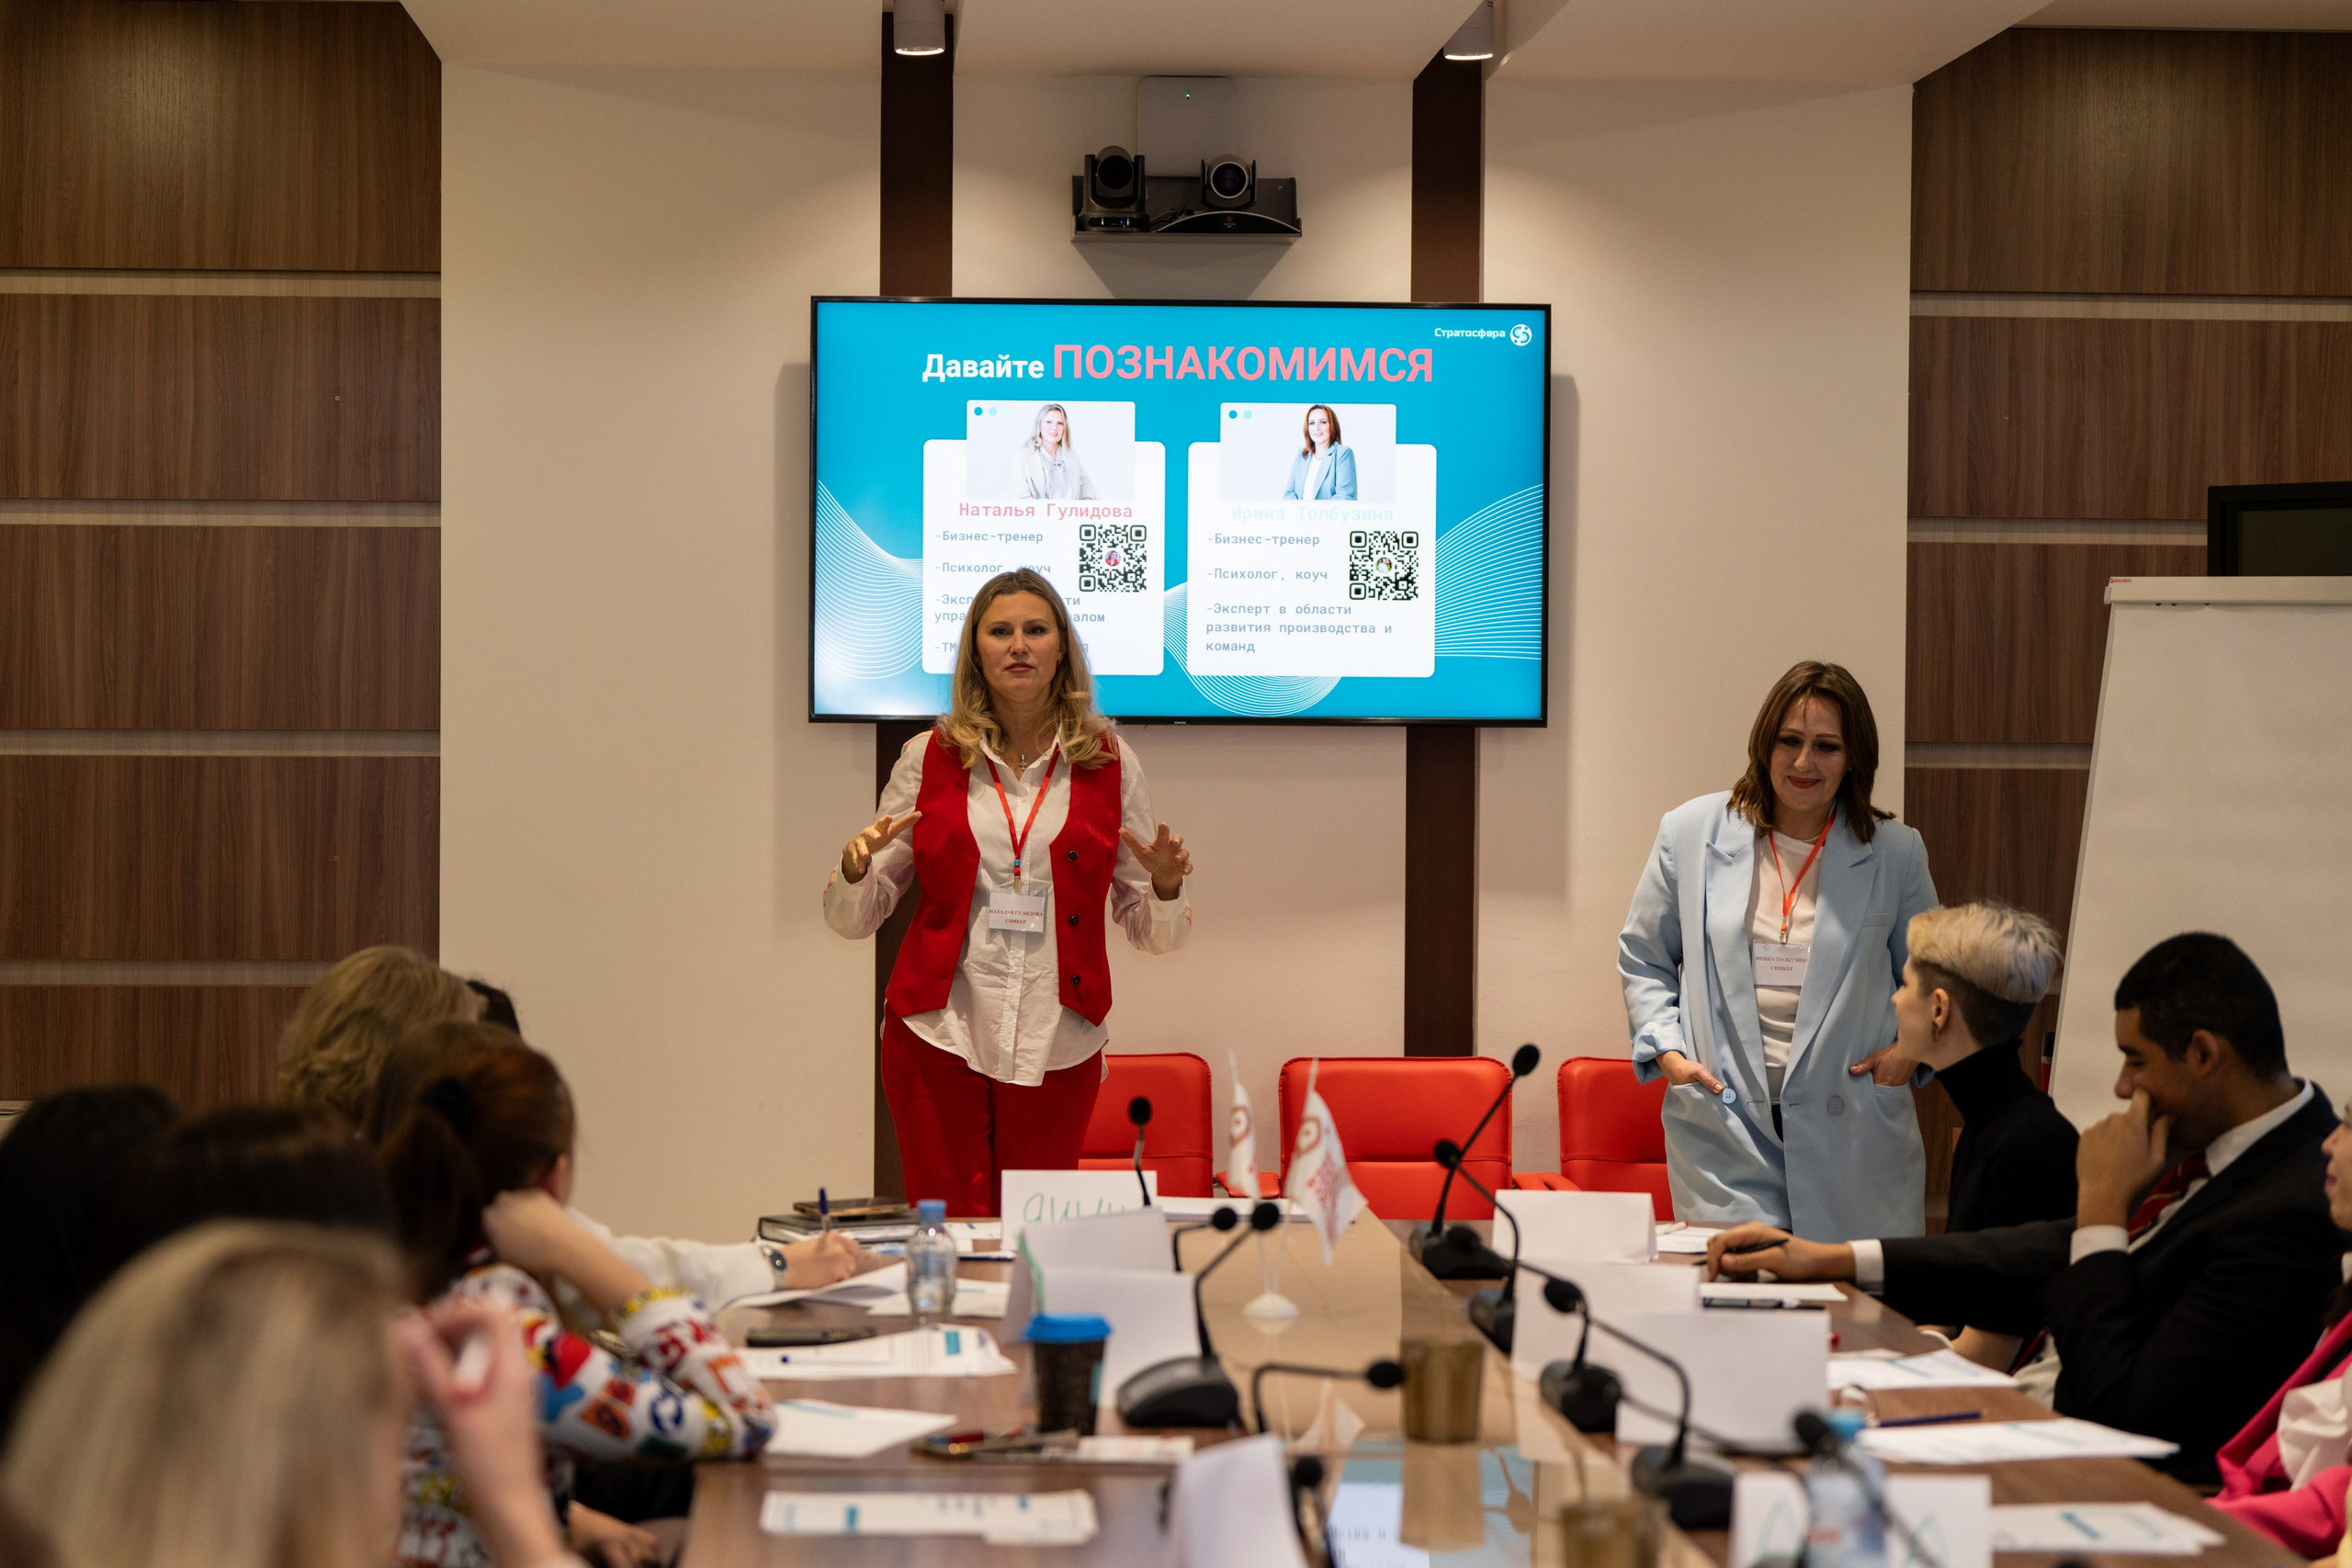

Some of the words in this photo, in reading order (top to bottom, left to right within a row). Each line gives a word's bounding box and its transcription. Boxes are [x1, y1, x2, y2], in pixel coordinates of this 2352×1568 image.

[1434, 327, 1506, 339] Стратосфера
[922, 354, 1045, 382] Давайте
[1054, 344, 1433, 382] ПОЗНАКОМИМСЯ
[959, 502, 1035, 517] Наталья
[1046, 503, 1133, 520] Гулидова
[1231, 506, 1285, 523] Ирина
[1297, 506, 1394, 524] Толбузина
[935, 531, 1044, 544] -Бизнес-тренер
[1207, 534, 1320, 547] -Бизнес-тренер
[1207, 569, 1285, 581] -Психолог,
[1295, 571, 1329, 582] коуч
[1207, 603, 1272, 616] -Эксперт
[1279, 606, 1287, 615] в
[1295, 604, 1352, 615] области
[1206, 623, 1272, 634] развития
[1280, 624, 1376, 636] производства
[1385, 626, 1393, 634] и
[1206, 643, 1256, 654] команд
